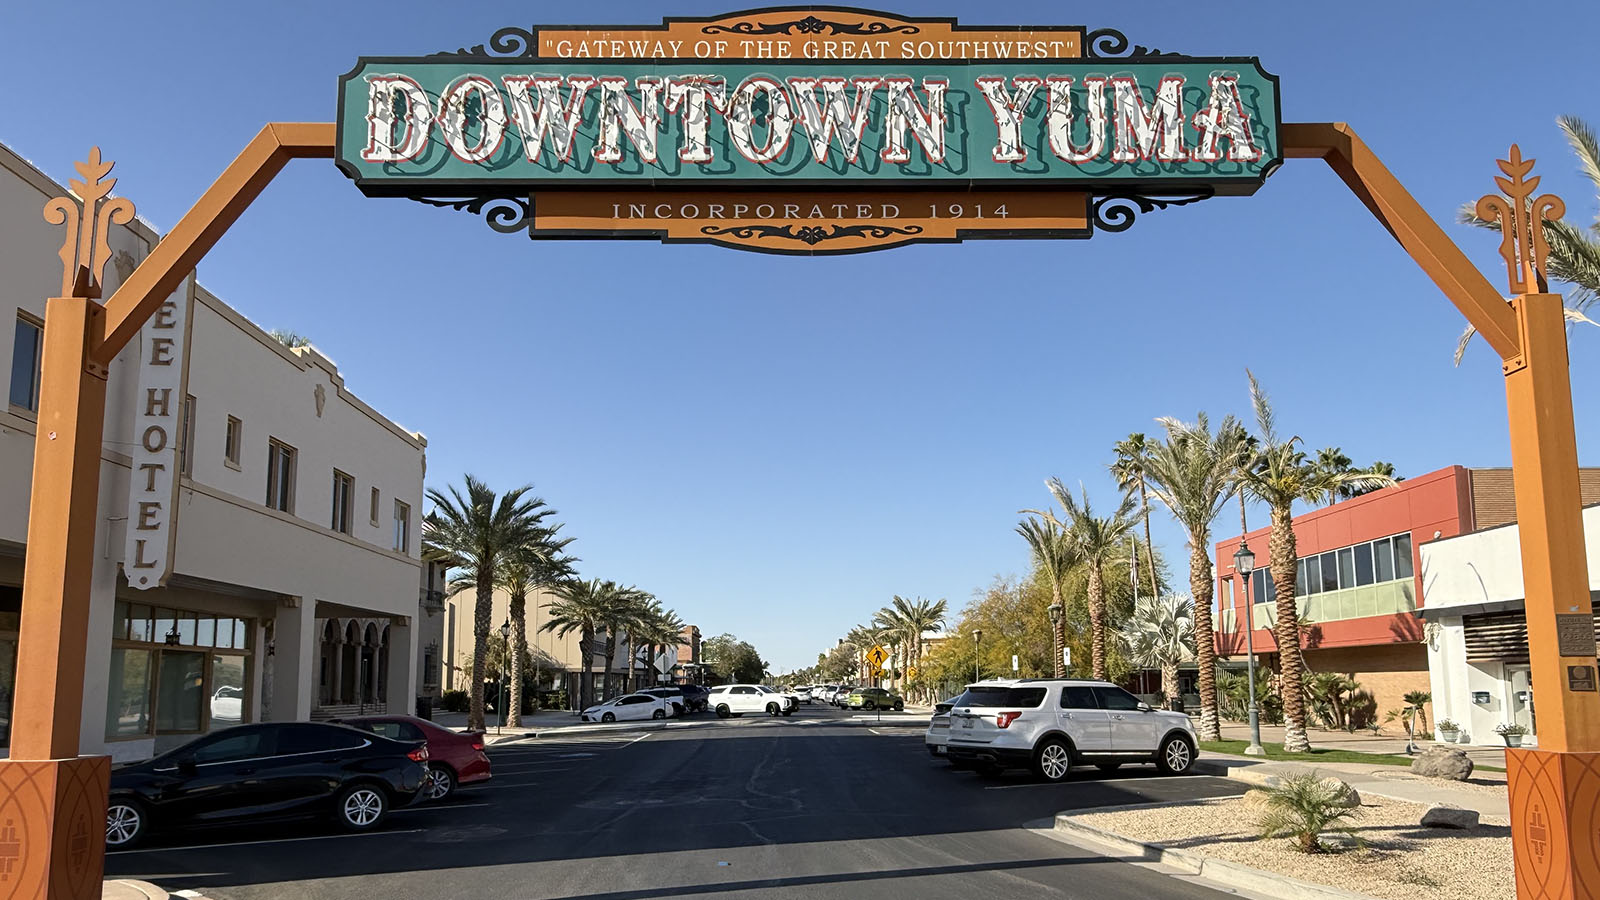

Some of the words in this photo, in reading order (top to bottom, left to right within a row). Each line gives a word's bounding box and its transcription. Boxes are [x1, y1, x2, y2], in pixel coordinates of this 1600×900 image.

[546, 40, 684, 58] "GATEWAY
[694, 40, 729, 59] OF
[739, 40, 793, 59] THE
[802, 40, 890, 59] GREAT
[901, 41, 1073, 59] SOUTHWEST"
[361, 73, 963, 163] DOWNTOWN
[974, 71, 1265, 163] YUMA
[612, 204, 900, 219] INCORPORATED
[929, 204, 1009, 219] 1914
[149, 301, 177, 366] EE
[134, 388, 171, 569] HOTEL
